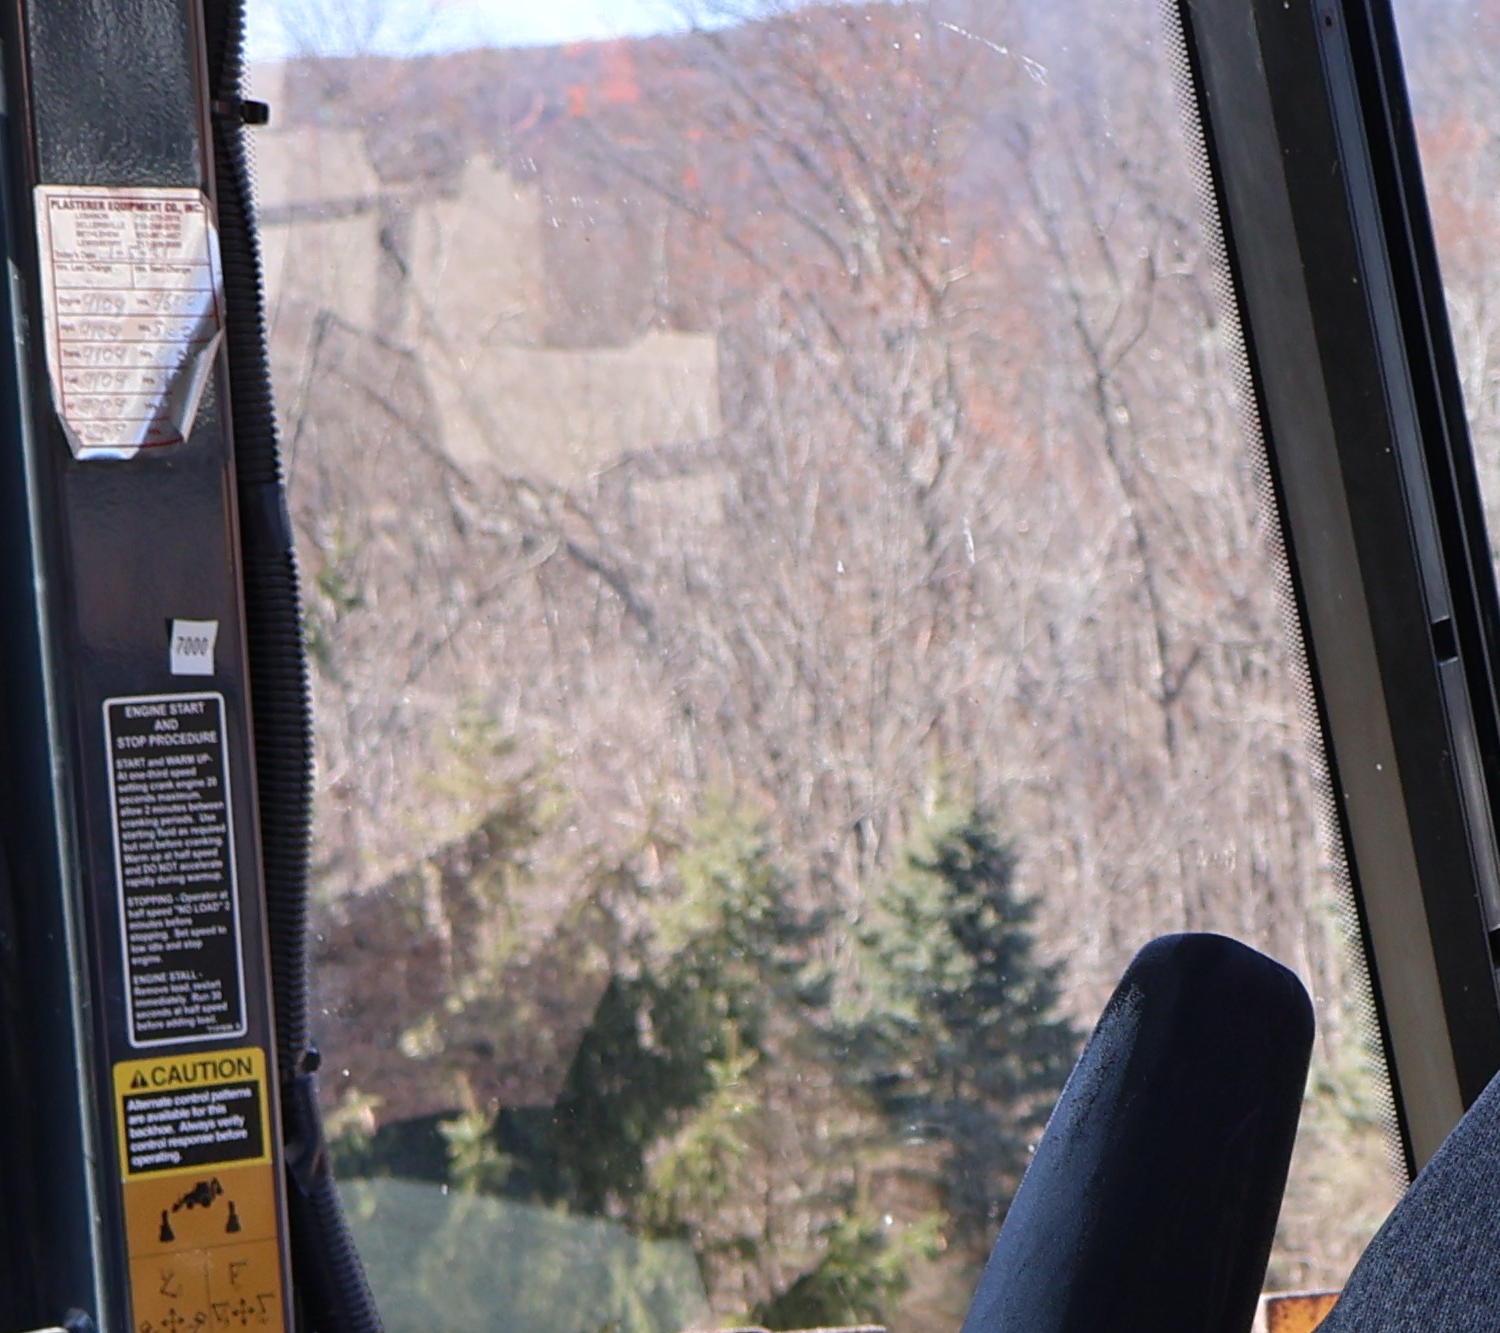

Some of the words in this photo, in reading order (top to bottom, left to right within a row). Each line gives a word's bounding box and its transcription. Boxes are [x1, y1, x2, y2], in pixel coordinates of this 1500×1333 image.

[51, 200, 105, 210] PLASTERER
[107, 202, 162, 211] EQUIPMENT
[124, 703, 167, 718] ENGINE
[168, 700, 205, 715] START
[153, 717, 179, 731] AND
[116, 734, 147, 749] STOP
[148, 729, 218, 748] PROCEDURE
[116, 756, 146, 770] START
[146, 755, 164, 768] and
[165, 753, 195, 766] WARM
[169, 766, 197, 779] speed
[142, 863, 157, 874] DO
[158, 861, 177, 873] NOT
[126, 892, 174, 908] STOPPING
[132, 971, 166, 985] ENGINE
[168, 968, 196, 982] STALL
[150, 1055, 252, 1087] CAUTION
[126, 1093, 173, 1111] Alternate
[173, 1090, 209, 1106] control
[210, 1085, 252, 1102] patterns
[127, 1112, 145, 1126] are
[145, 1106, 190, 1124] available
[190, 1104, 206, 1118] for
[206, 1102, 227, 1116] this
[177, 1116, 216, 1135] Always
[216, 1113, 245, 1131] verify
[129, 1136, 166, 1153] control
[167, 1131, 215, 1150] response
[215, 1127, 247, 1142] before
